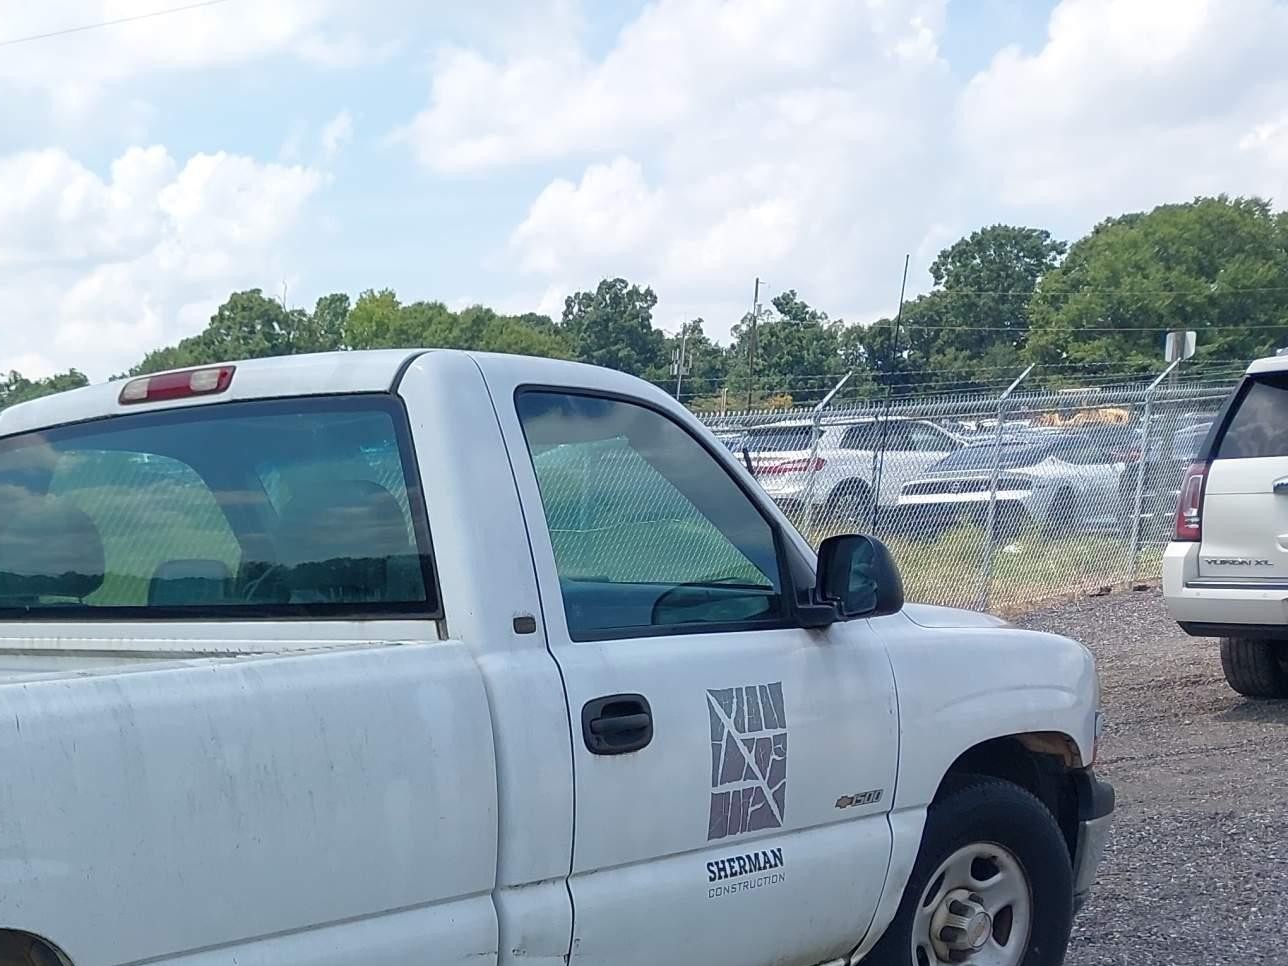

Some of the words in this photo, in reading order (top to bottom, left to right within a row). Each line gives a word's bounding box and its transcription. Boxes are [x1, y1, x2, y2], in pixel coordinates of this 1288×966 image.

[851, 789, 883, 807] 1500
[707, 848, 784, 882] SHERMAN
[708, 872, 786, 898] CONSTRUCTION
